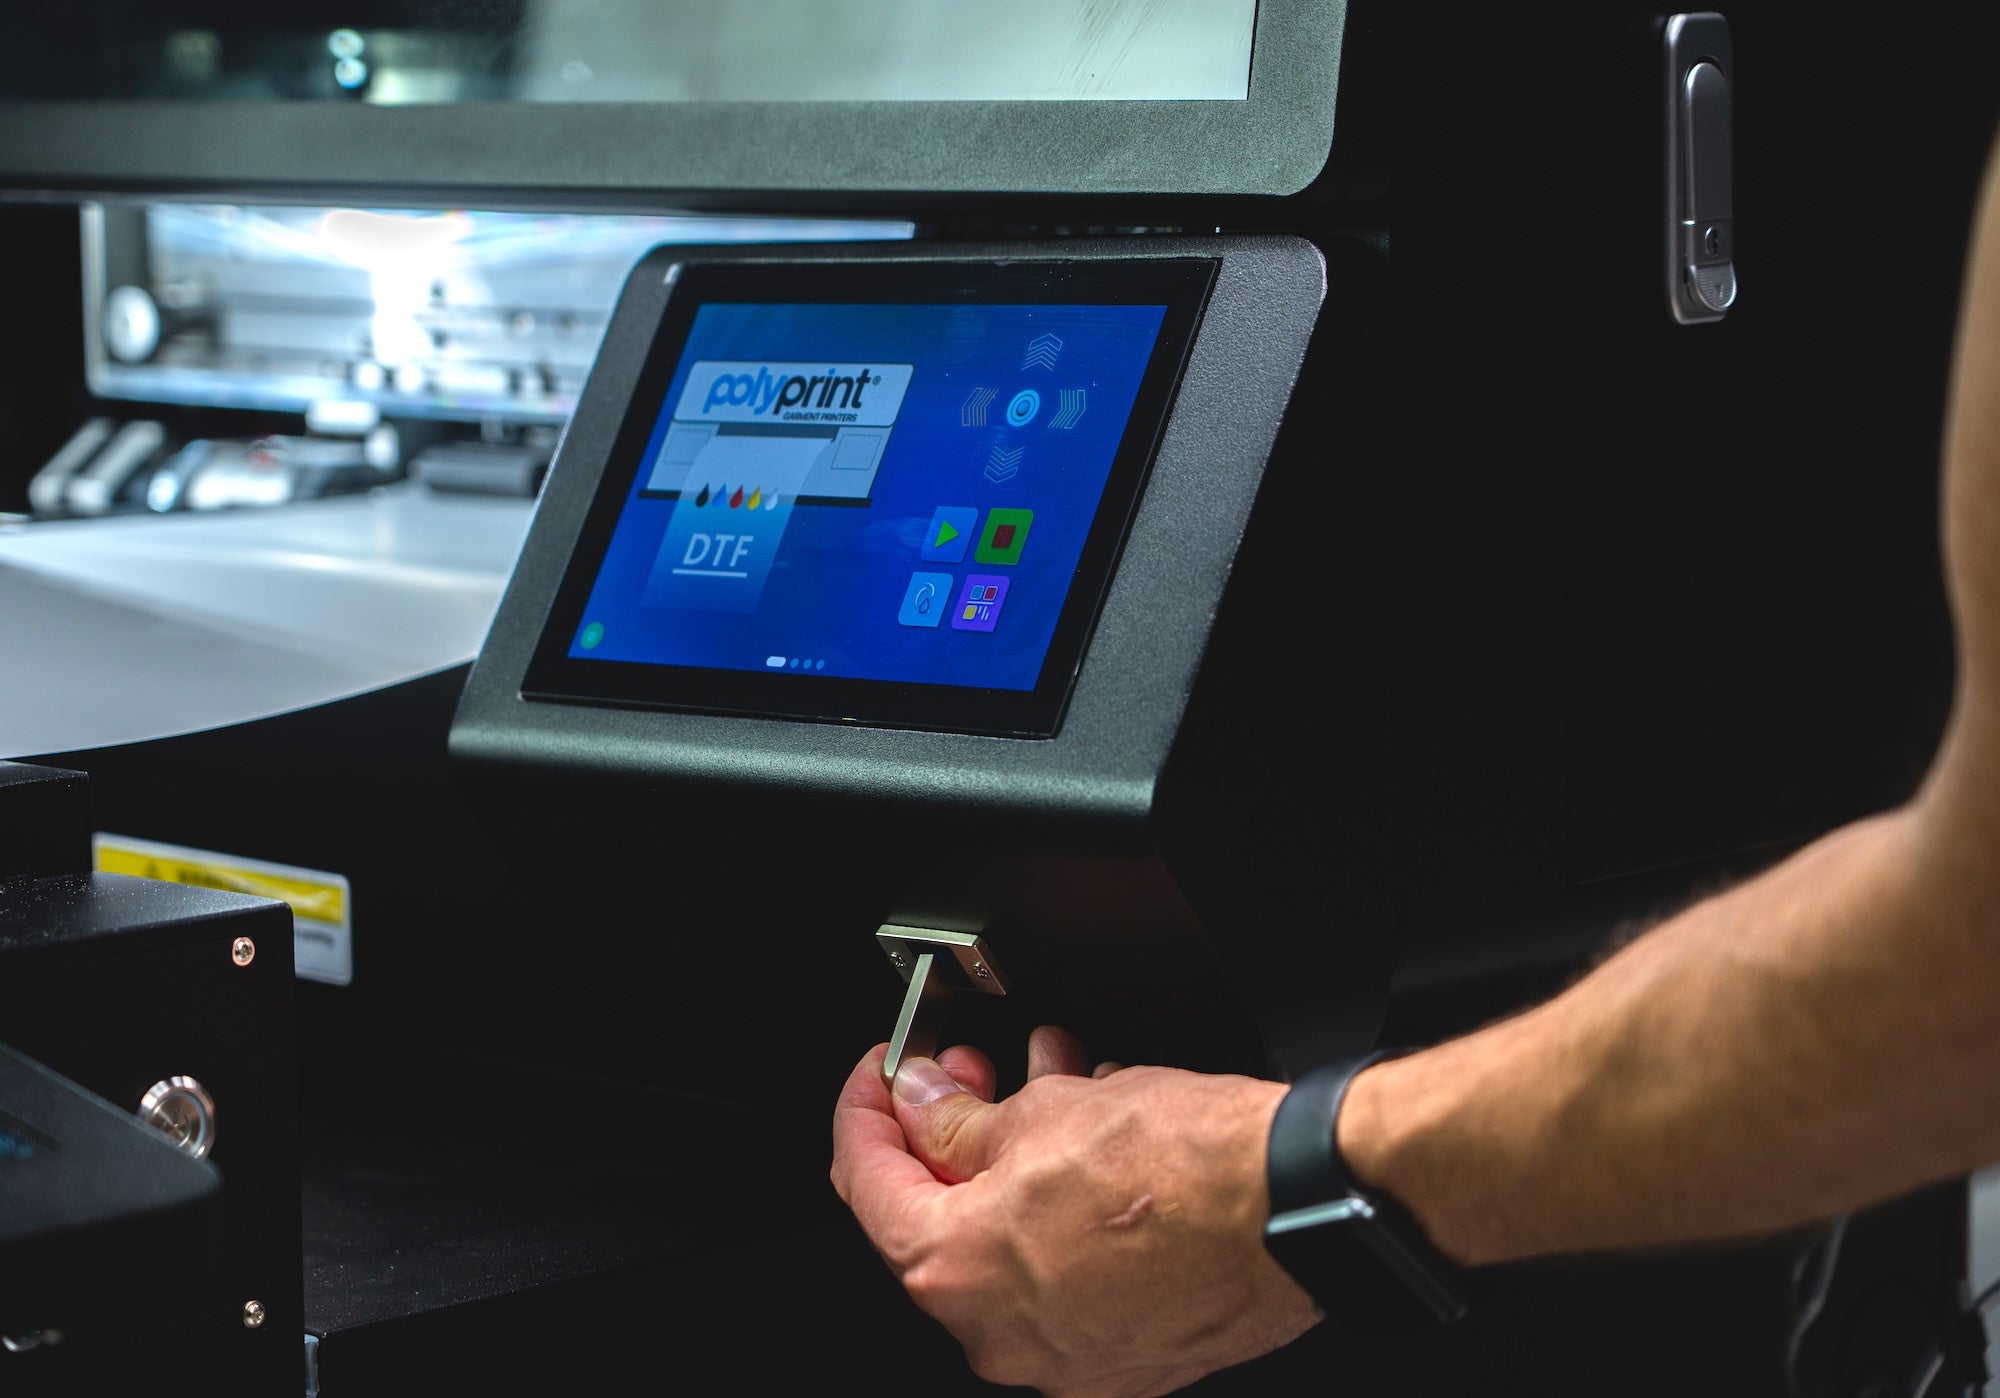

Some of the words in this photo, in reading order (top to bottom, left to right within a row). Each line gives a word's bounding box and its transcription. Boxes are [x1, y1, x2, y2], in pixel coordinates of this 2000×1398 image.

[783, 412, 820, 421] GARMENT
[820, 413, 858, 423] PRINTERS
[682, 533, 754, 567] DTF
